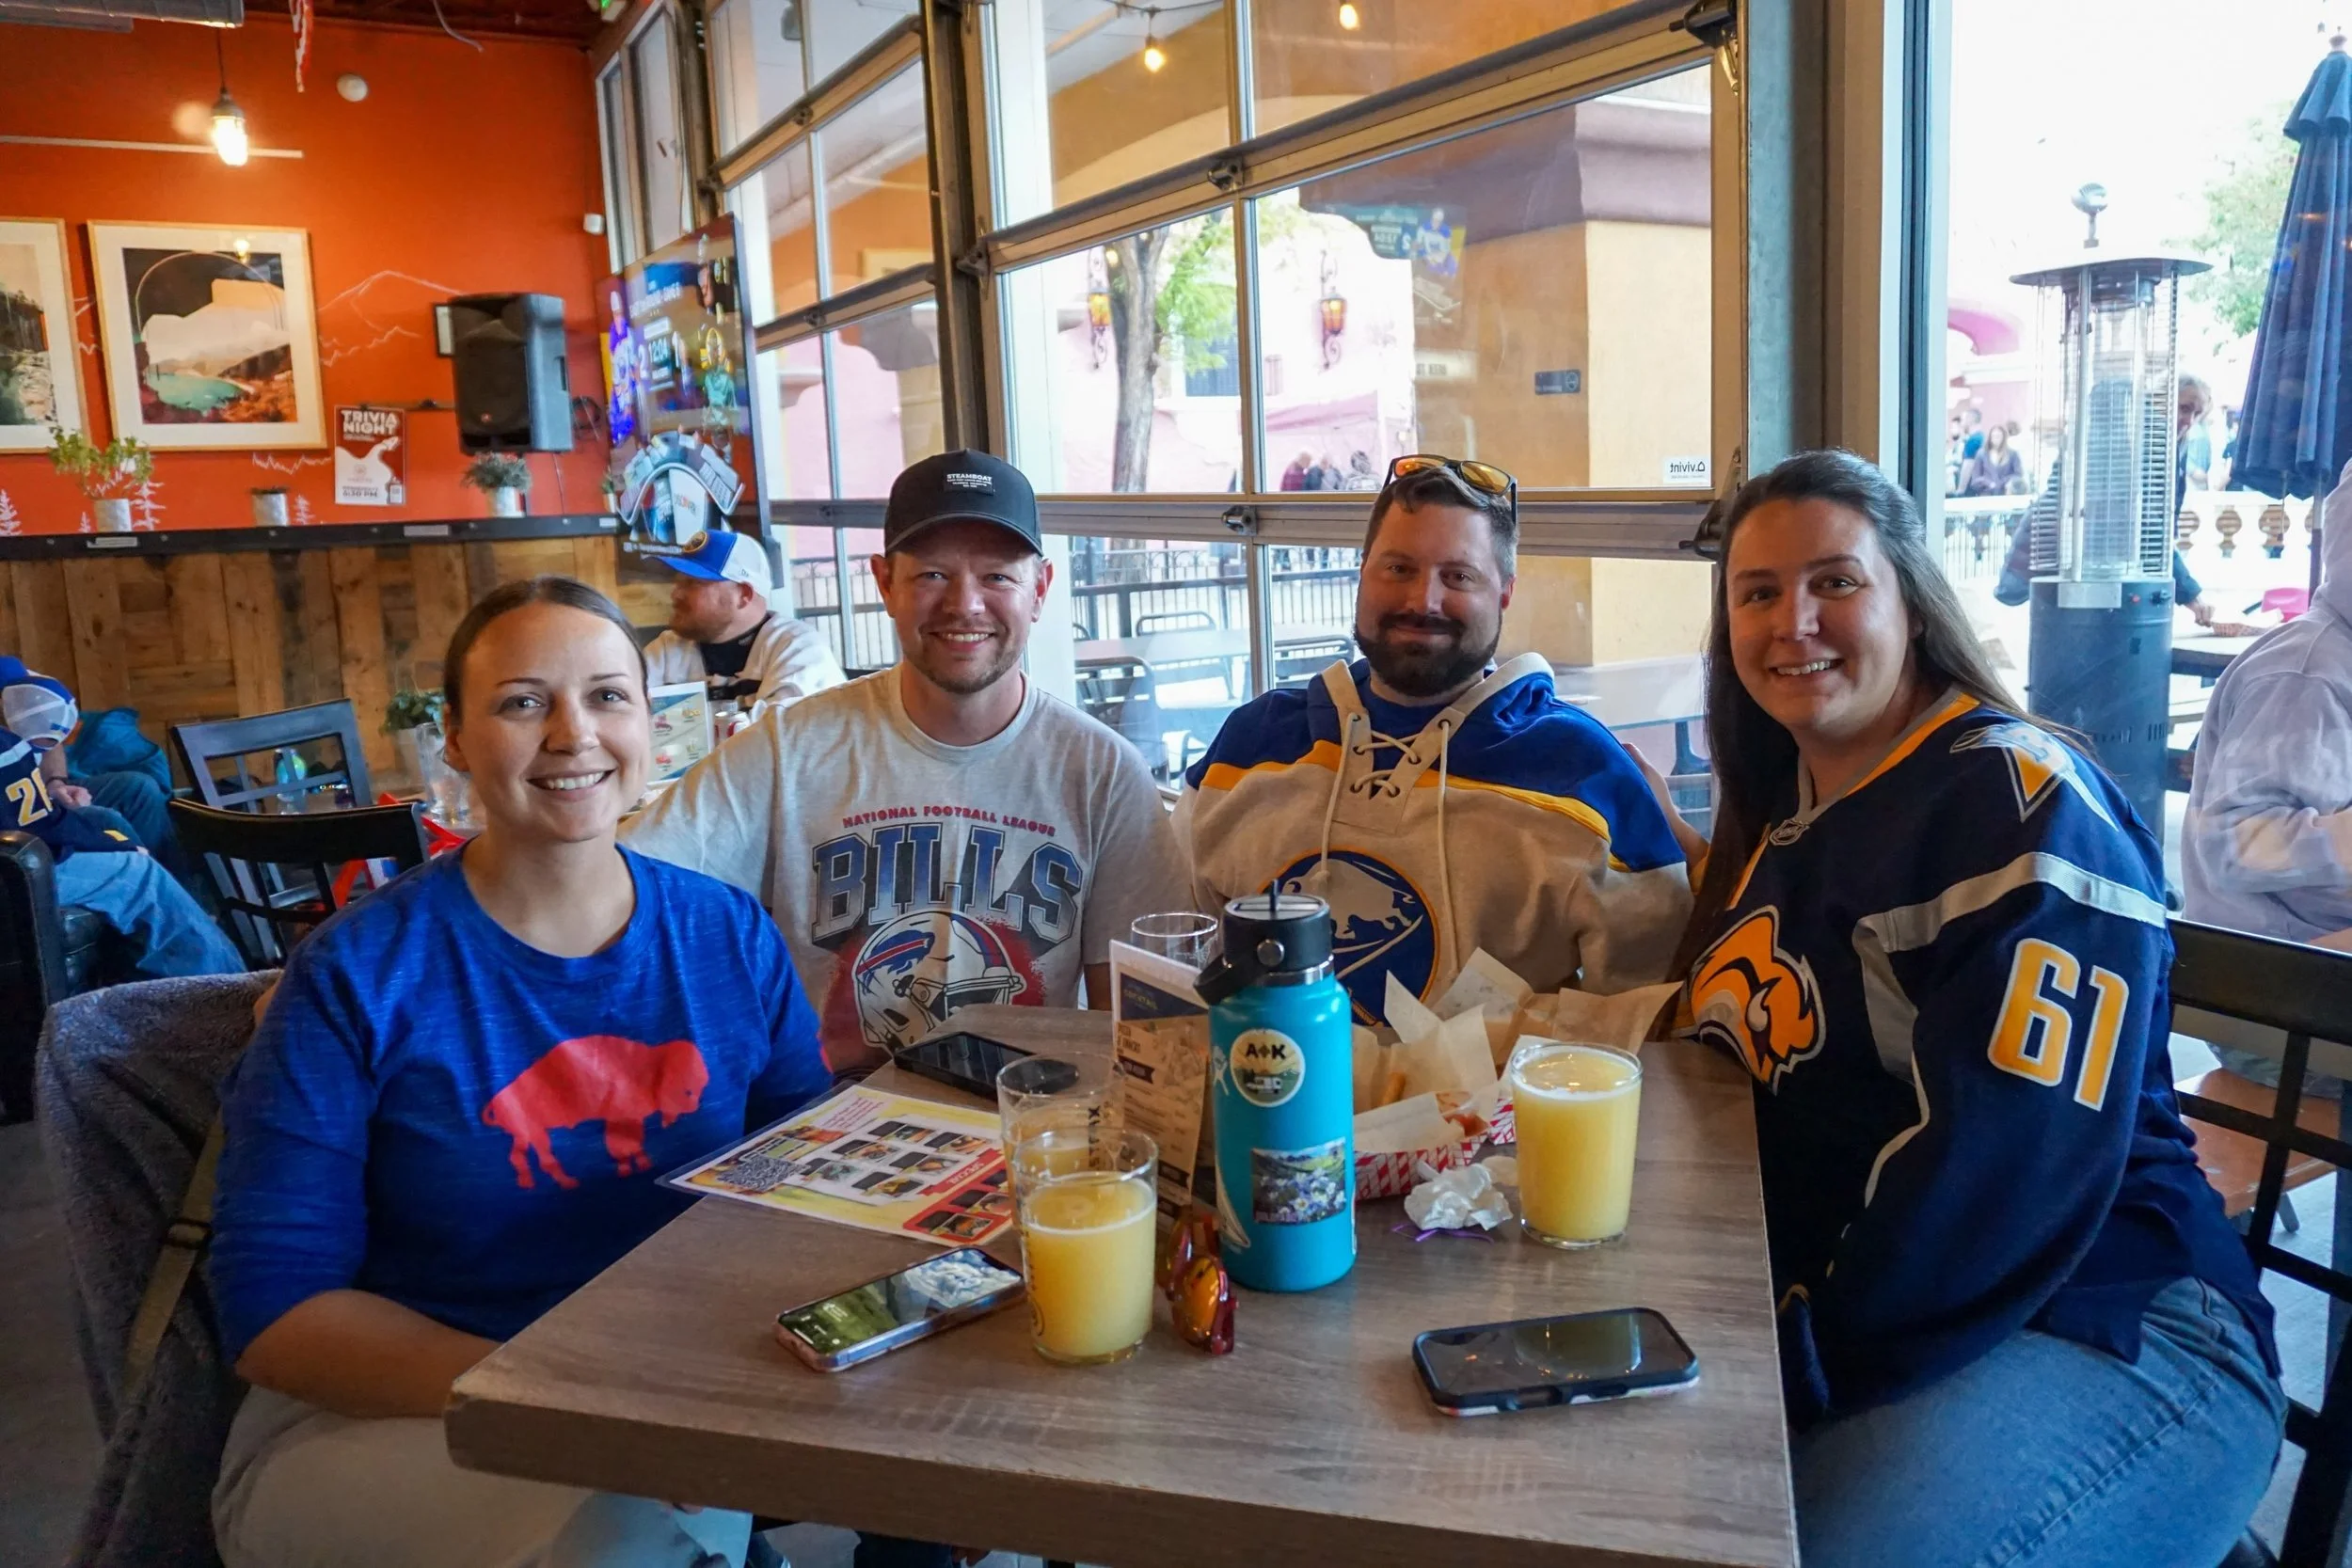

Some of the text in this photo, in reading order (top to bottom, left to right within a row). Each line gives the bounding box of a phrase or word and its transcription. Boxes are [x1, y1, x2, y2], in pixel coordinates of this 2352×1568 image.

[341, 409, 400, 428] TRIVIA
[342, 421, 395, 436] NIGHT
[946, 473, 993, 482] STEAMBOAT
[843, 805, 1057, 837] NATIONAL FOOTBALL LEAGUE
[812, 821, 1083, 944] BILLS
[1987, 938, 2130, 1112] 61
